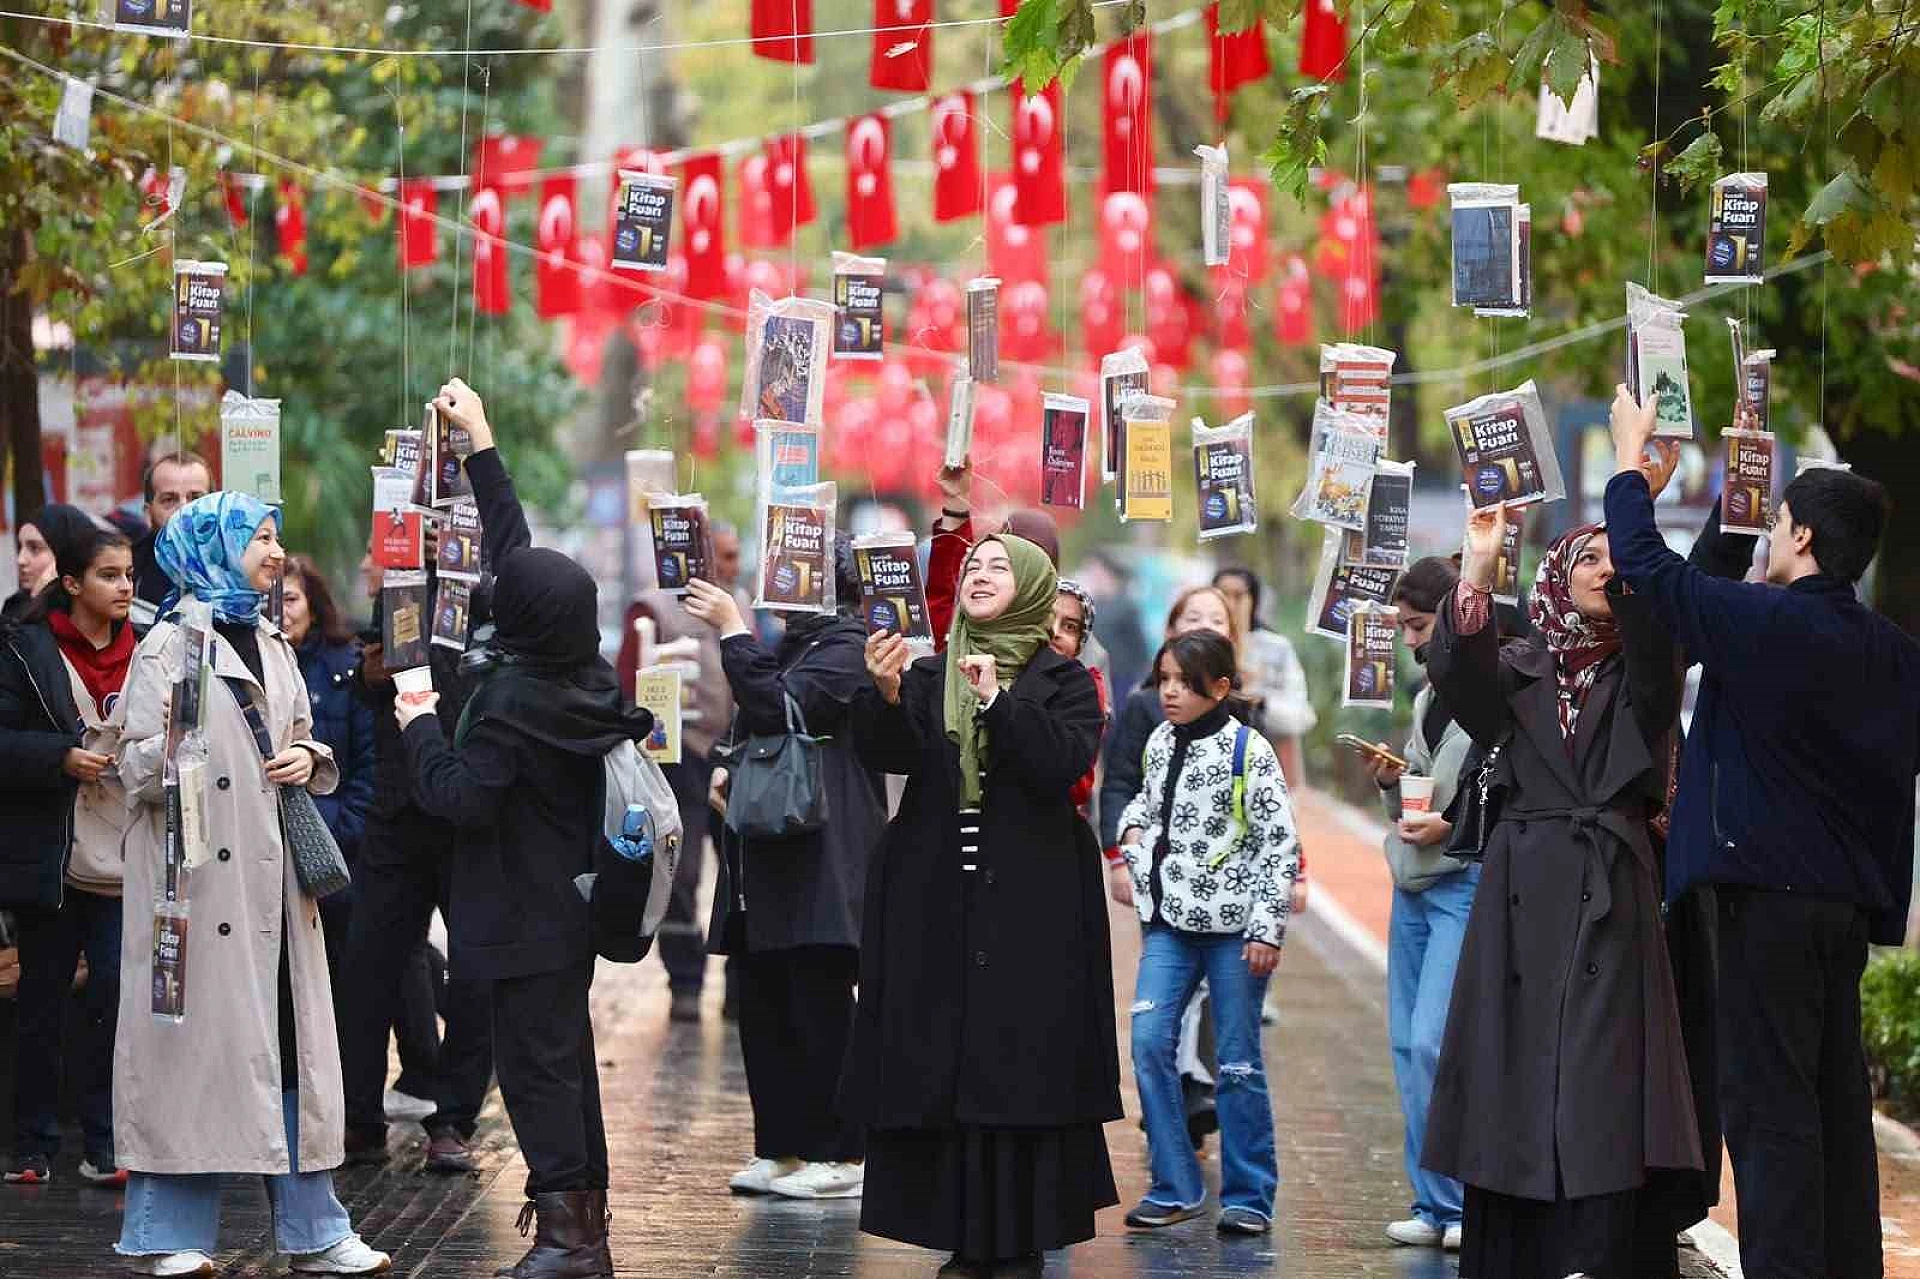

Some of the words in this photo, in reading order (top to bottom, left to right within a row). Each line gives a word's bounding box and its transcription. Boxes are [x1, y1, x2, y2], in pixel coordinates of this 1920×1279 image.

[629, 190, 665, 207] Kitap
[1723, 199, 1759, 212] Kitap
[190, 286, 220, 300] Kitap
[849, 285, 881, 300] Kitap
[1474, 418, 1518, 440] Kitap
[1210, 453, 1243, 468] Kitap
[1740, 450, 1769, 466] Kitap
[663, 518, 691, 531] Kitap
[784, 520, 823, 539] Kitap
[871, 559, 911, 574] Kitap
